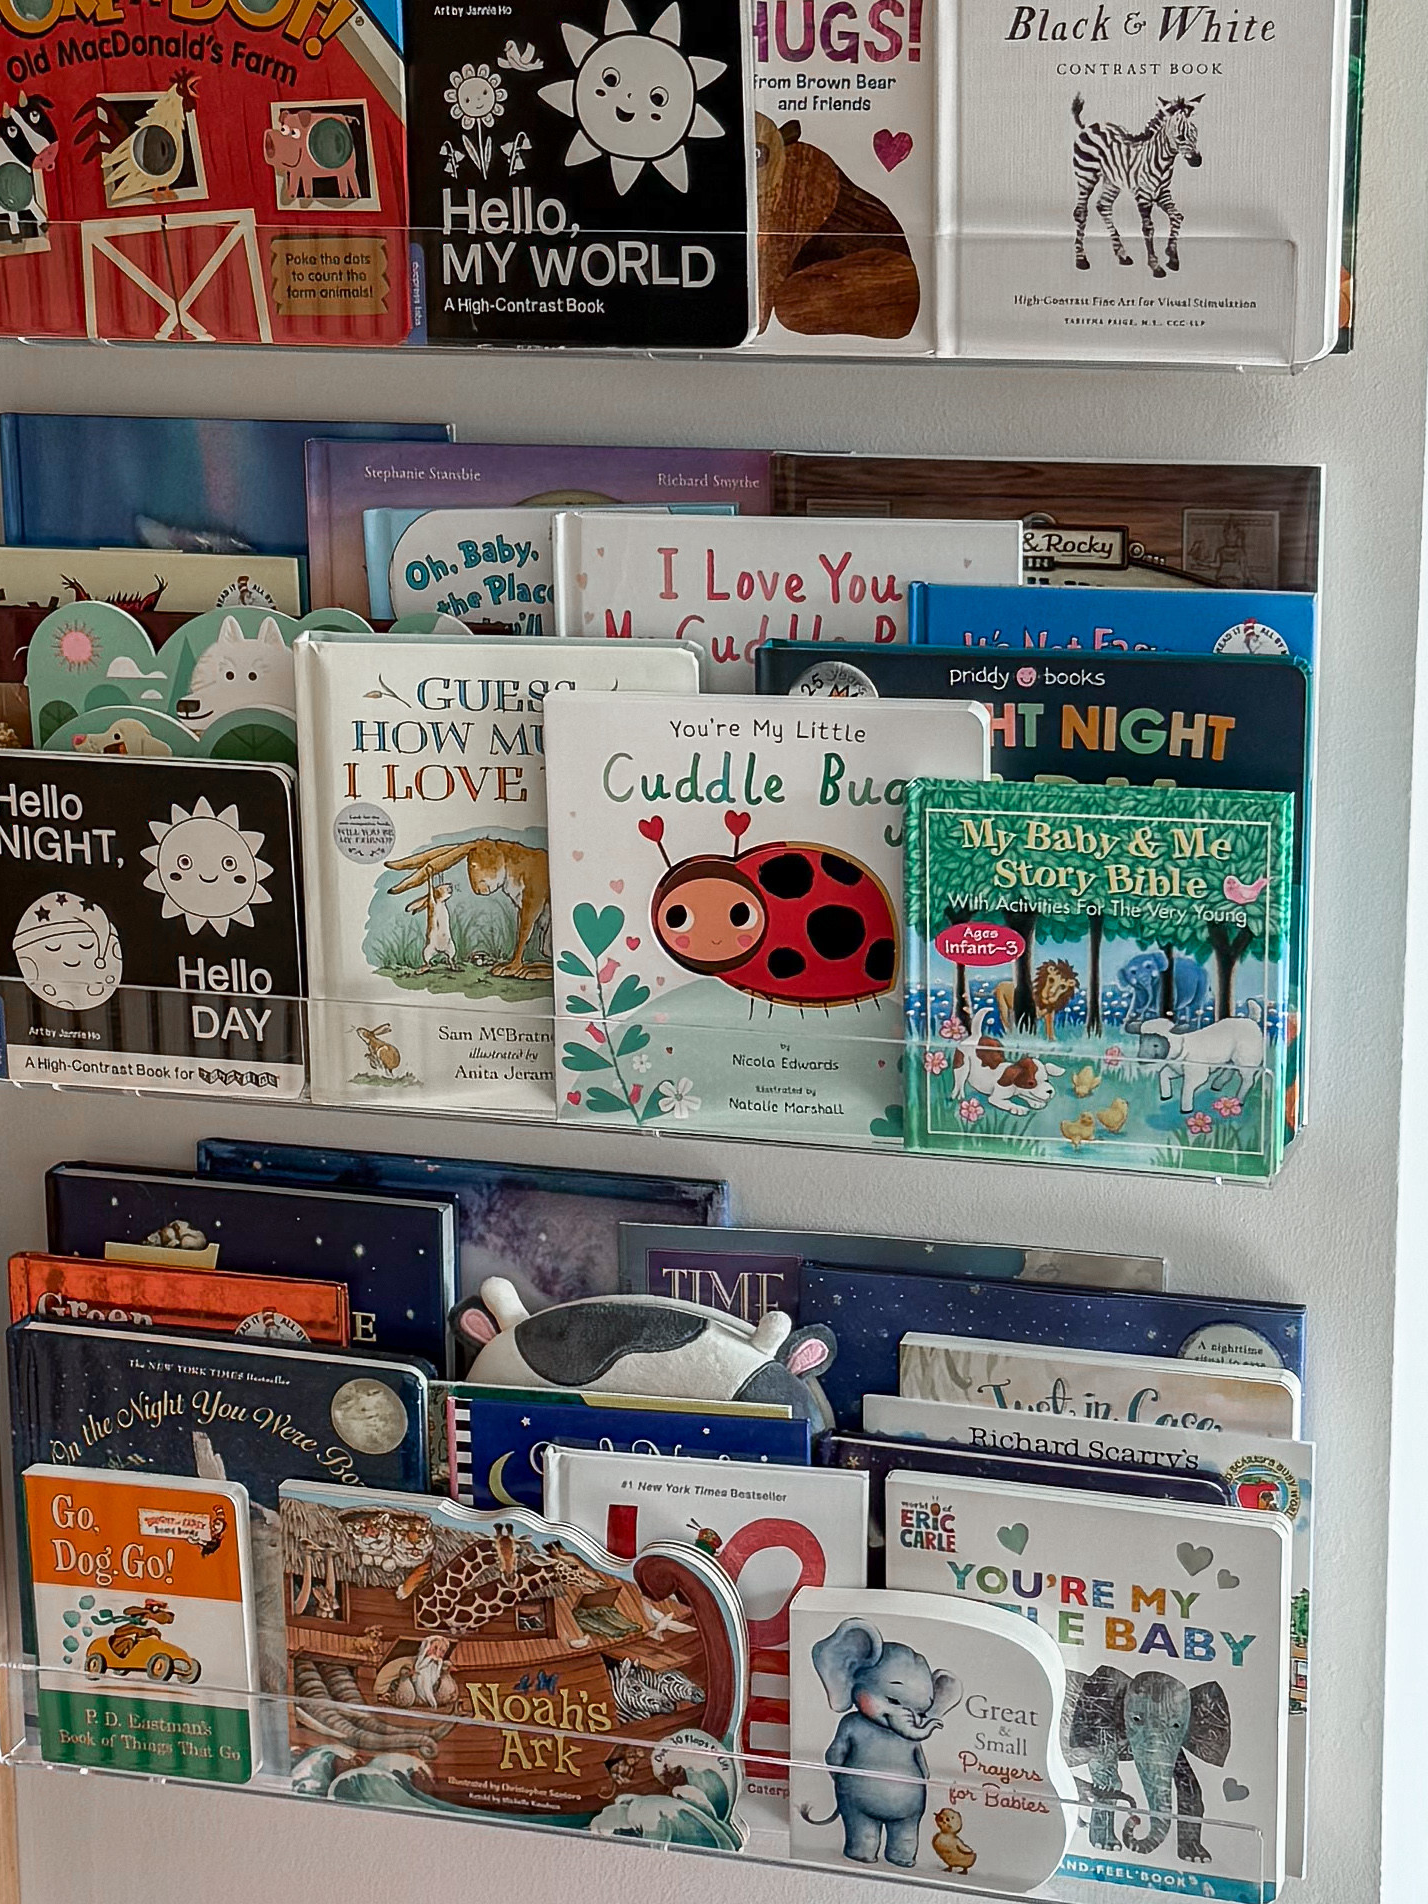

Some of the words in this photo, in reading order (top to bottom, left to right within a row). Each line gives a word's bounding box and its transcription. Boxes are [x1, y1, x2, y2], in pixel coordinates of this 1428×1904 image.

[1005, 4, 1111, 43] Black
[1123, 11, 1147, 34] &
[1158, 3, 1277, 44] White
[5, 40, 49, 85] Old
[56, 30, 226, 68] MacDonald's
[229, 41, 299, 88] Farm
[1056, 61, 1161, 77] CONTRAST
[1169, 61, 1223, 76] BOOK
[777, 97, 808, 111] and
[811, 96, 871, 112] Friends
[441, 186, 580, 239] Hello,
[285, 252, 317, 267] Poke
[320, 252, 342, 266] the
[344, 252, 371, 266] dots
[441, 240, 518, 286] MY
[529, 242, 716, 289] WORLD
[286, 284, 316, 299] farm
[318, 284, 373, 299] animals!
[292, 270, 306, 283] to
[308, 270, 344, 283] count
[346, 269, 367, 283] the
[444, 298, 456, 312] A
[458, 297, 565, 315] High-Contrast
[566, 298, 606, 314] Book
[656, 472, 710, 489] Richard
[712, 474, 761, 493] Smythe
[405, 554, 459, 592] Oh,
[457, 534, 540, 569] Baby,
[657, 546, 679, 600] I
[706, 548, 807, 604] Love
[818, 551, 903, 604] You
[950, 666, 1010, 690] priddy
[1044, 667, 1106, 687] books
[670, 719, 742, 742] You're
[753, 717, 785, 745] My
[796, 720, 867, 744] Little
[343, 761, 362, 801] I
[382, 762, 529, 804] LOVE
[960, 818, 1018, 857] My
[1023, 819, 1122, 861] Baby
[1127, 826, 1168, 859] &
[1170, 827, 1233, 860] Me
[993, 859, 1097, 898] Story
[1104, 863, 1208, 899] Bible
[948, 893, 990, 912] With
[996, 895, 1071, 916] Activities
[1076, 899, 1105, 917] For
[1110, 900, 1142, 918] The
[1146, 904, 1188, 924] Very
[1192, 905, 1248, 929] Young
[962, 927, 999, 941] Ages
[178, 955, 274, 994] Hello
[192, 1004, 273, 1042] DAY
[24, 1056, 35, 1070] A
[37, 1057, 134, 1077] High-Contrast
[136, 1063, 172, 1080] Book
[174, 1066, 195, 1081] for
[454, 1065, 499, 1080] Anita
[732, 1054, 776, 1069] Nicola
[781, 1057, 840, 1071] Edwards
[784, 1101, 845, 1115] Marshall
[968, 1426, 1080, 1458] Richard
[1088, 1440, 1200, 1470] Scarry's
[51, 1494, 100, 1535] Go,
[900, 1499, 931, 1513] world
[941, 1501, 954, 1512] of
[900, 1508, 956, 1533] ERIC
[899, 1528, 957, 1554] CARLE
[946, 1560, 1115, 1610] YOU'RE
[1130, 1584, 1202, 1620] MY
[1104, 1616, 1258, 1667] BABY
[85, 1708, 99, 1725] P.
[105, 1711, 122, 1727] D.
[127, 1713, 213, 1737] Eastman's
[465, 1682, 613, 1734] Noah's
[965, 1695, 1040, 1728] Great
[58, 1728, 96, 1746] Book
[101, 1735, 117, 1748] of
[120, 1734, 173, 1756] Things
[177, 1740, 214, 1758] That
[218, 1746, 241, 1761] Go
[974, 1728, 1028, 1757] Small
[998, 1726, 1012, 1738] &
[499, 1728, 582, 1778] Ark
[958, 1750, 1044, 1784] Prayers
[948, 1784, 977, 1808] for
[982, 1786, 1050, 1815] Babies
